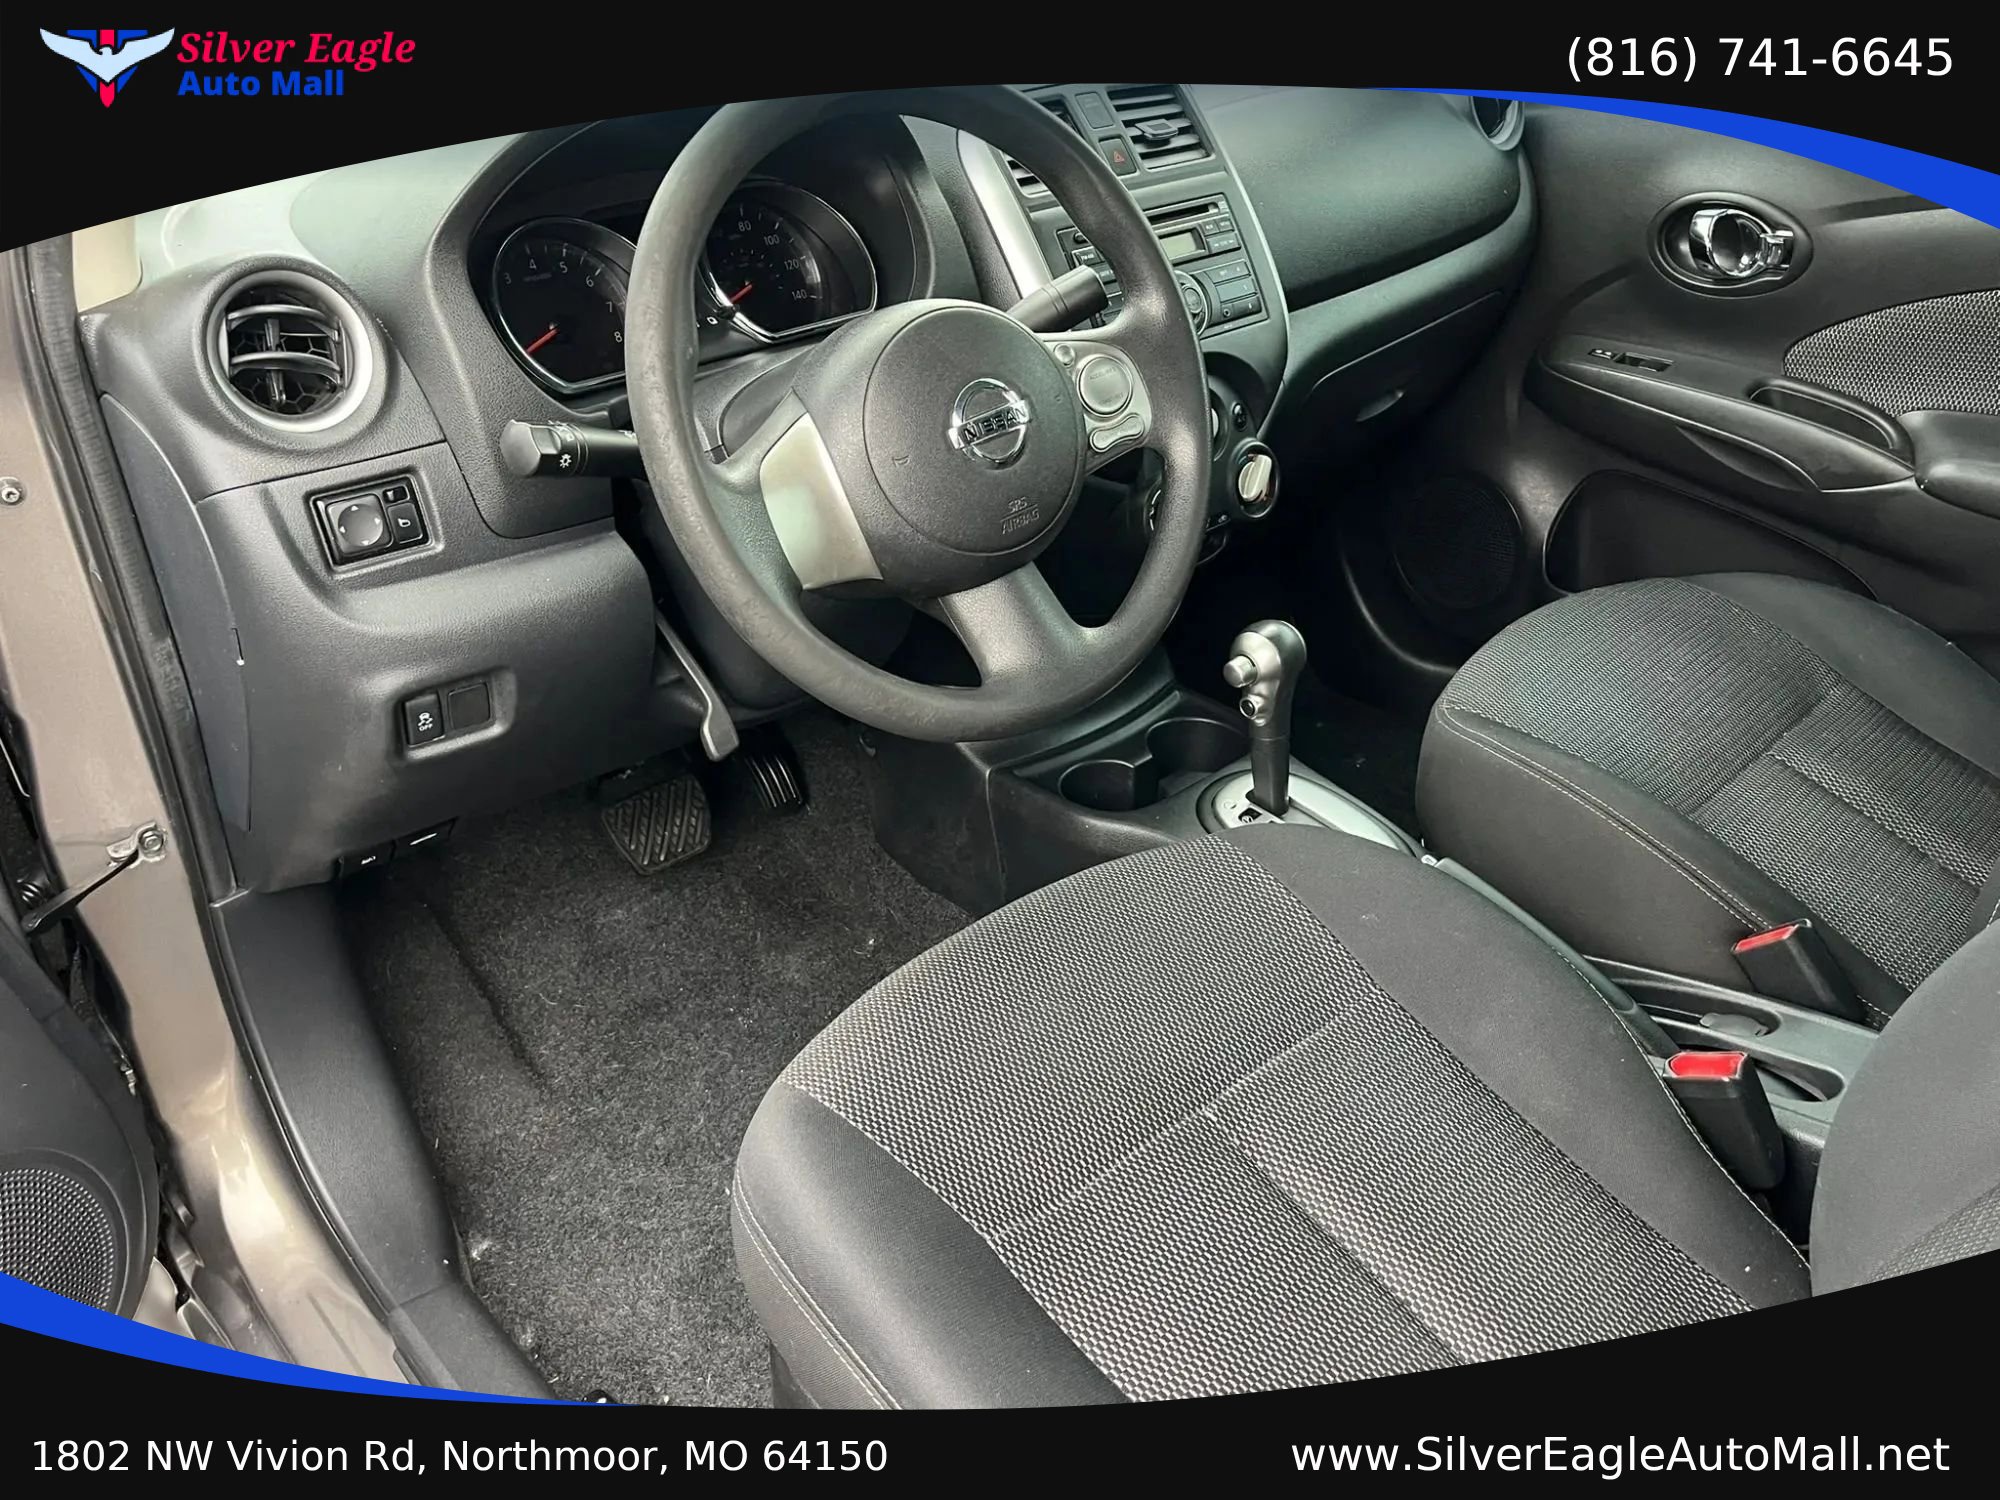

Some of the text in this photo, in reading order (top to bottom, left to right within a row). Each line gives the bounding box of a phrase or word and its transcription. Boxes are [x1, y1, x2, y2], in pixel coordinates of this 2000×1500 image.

[738, 220, 752, 232] 80
[763, 233, 781, 246] 100
[529, 258, 537, 270] 4
[559, 261, 568, 274] 5
[784, 258, 800, 271] 120
[503, 272, 512, 285] 3
[585, 275, 595, 288] 6
[791, 288, 808, 301] 140
[605, 301, 613, 313] 7
[613, 331, 623, 343] 8
[962, 405, 1028, 443] NISSAN
